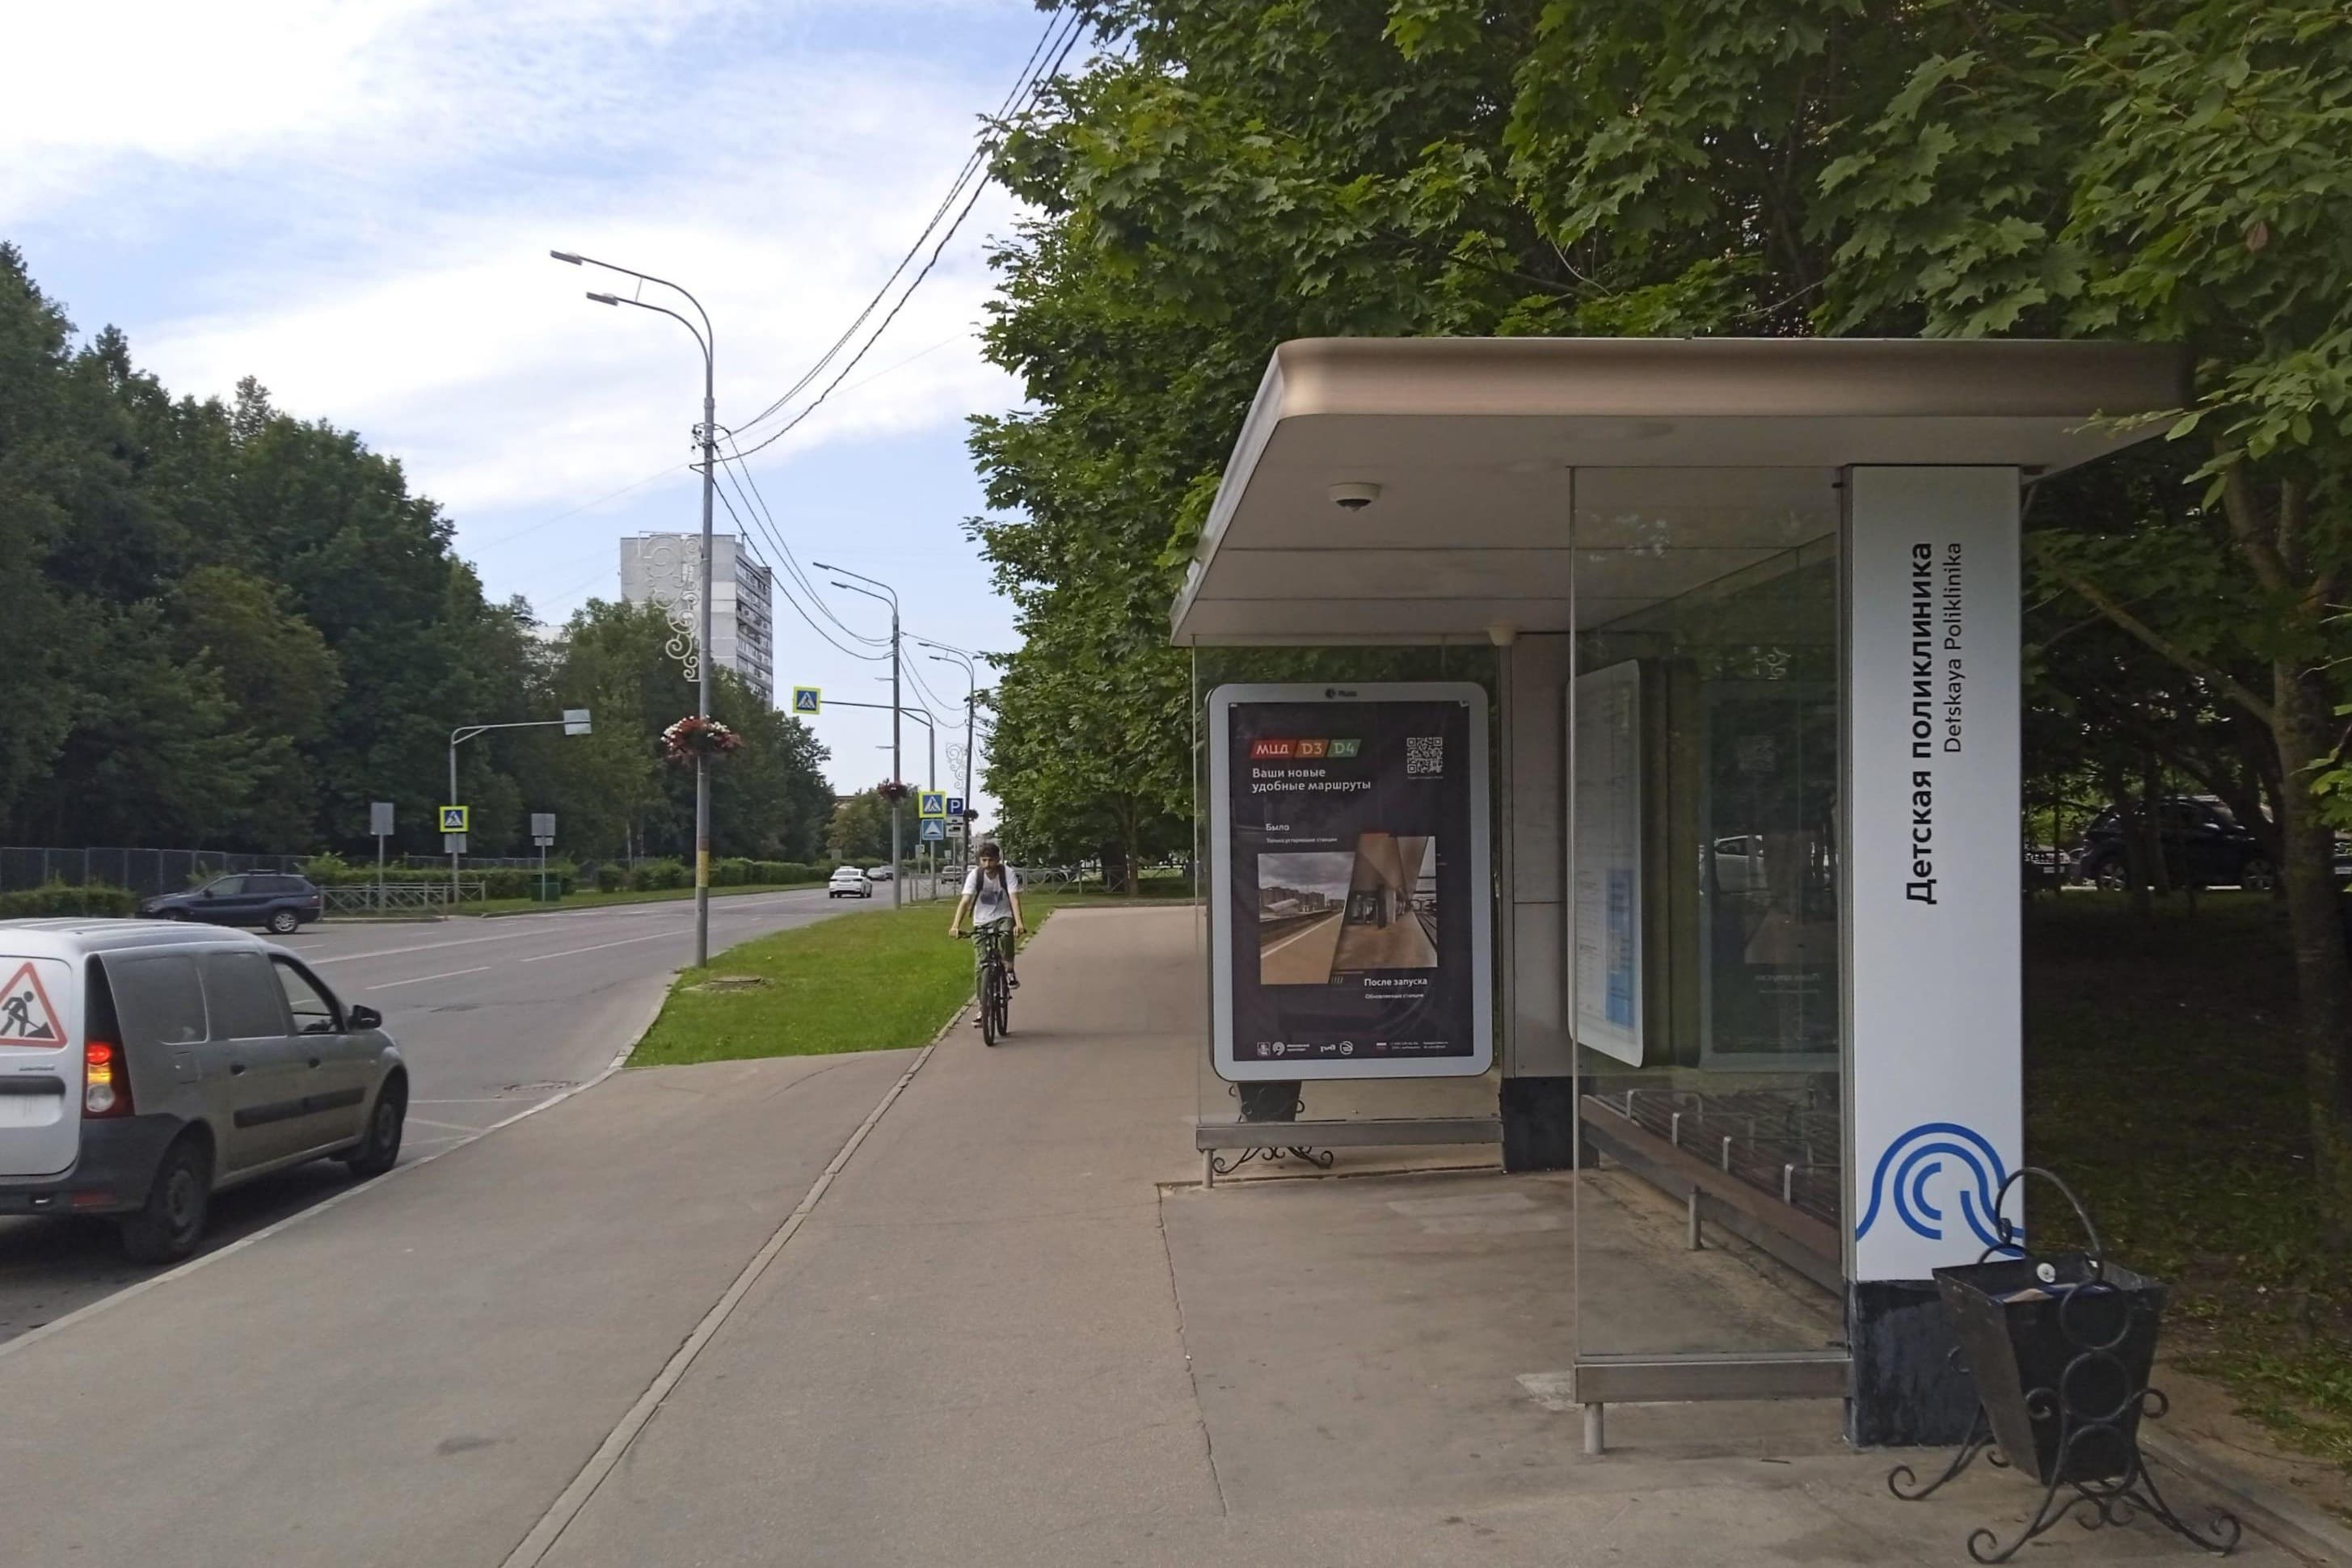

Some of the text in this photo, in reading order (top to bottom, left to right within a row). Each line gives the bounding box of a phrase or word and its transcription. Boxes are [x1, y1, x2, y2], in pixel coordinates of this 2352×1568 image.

[1943, 543, 1966, 752] Detskaya Poliklinika
[1907, 543, 1937, 904] Детская поликлиника
[1256, 742, 1355, 756] МЦД D3 D4
[1253, 768, 1326, 778] Ваши новые
[1252, 781, 1371, 794] удобные маршруты
[1266, 823, 1290, 832] Было
[1364, 978, 1427, 987] После запуска
